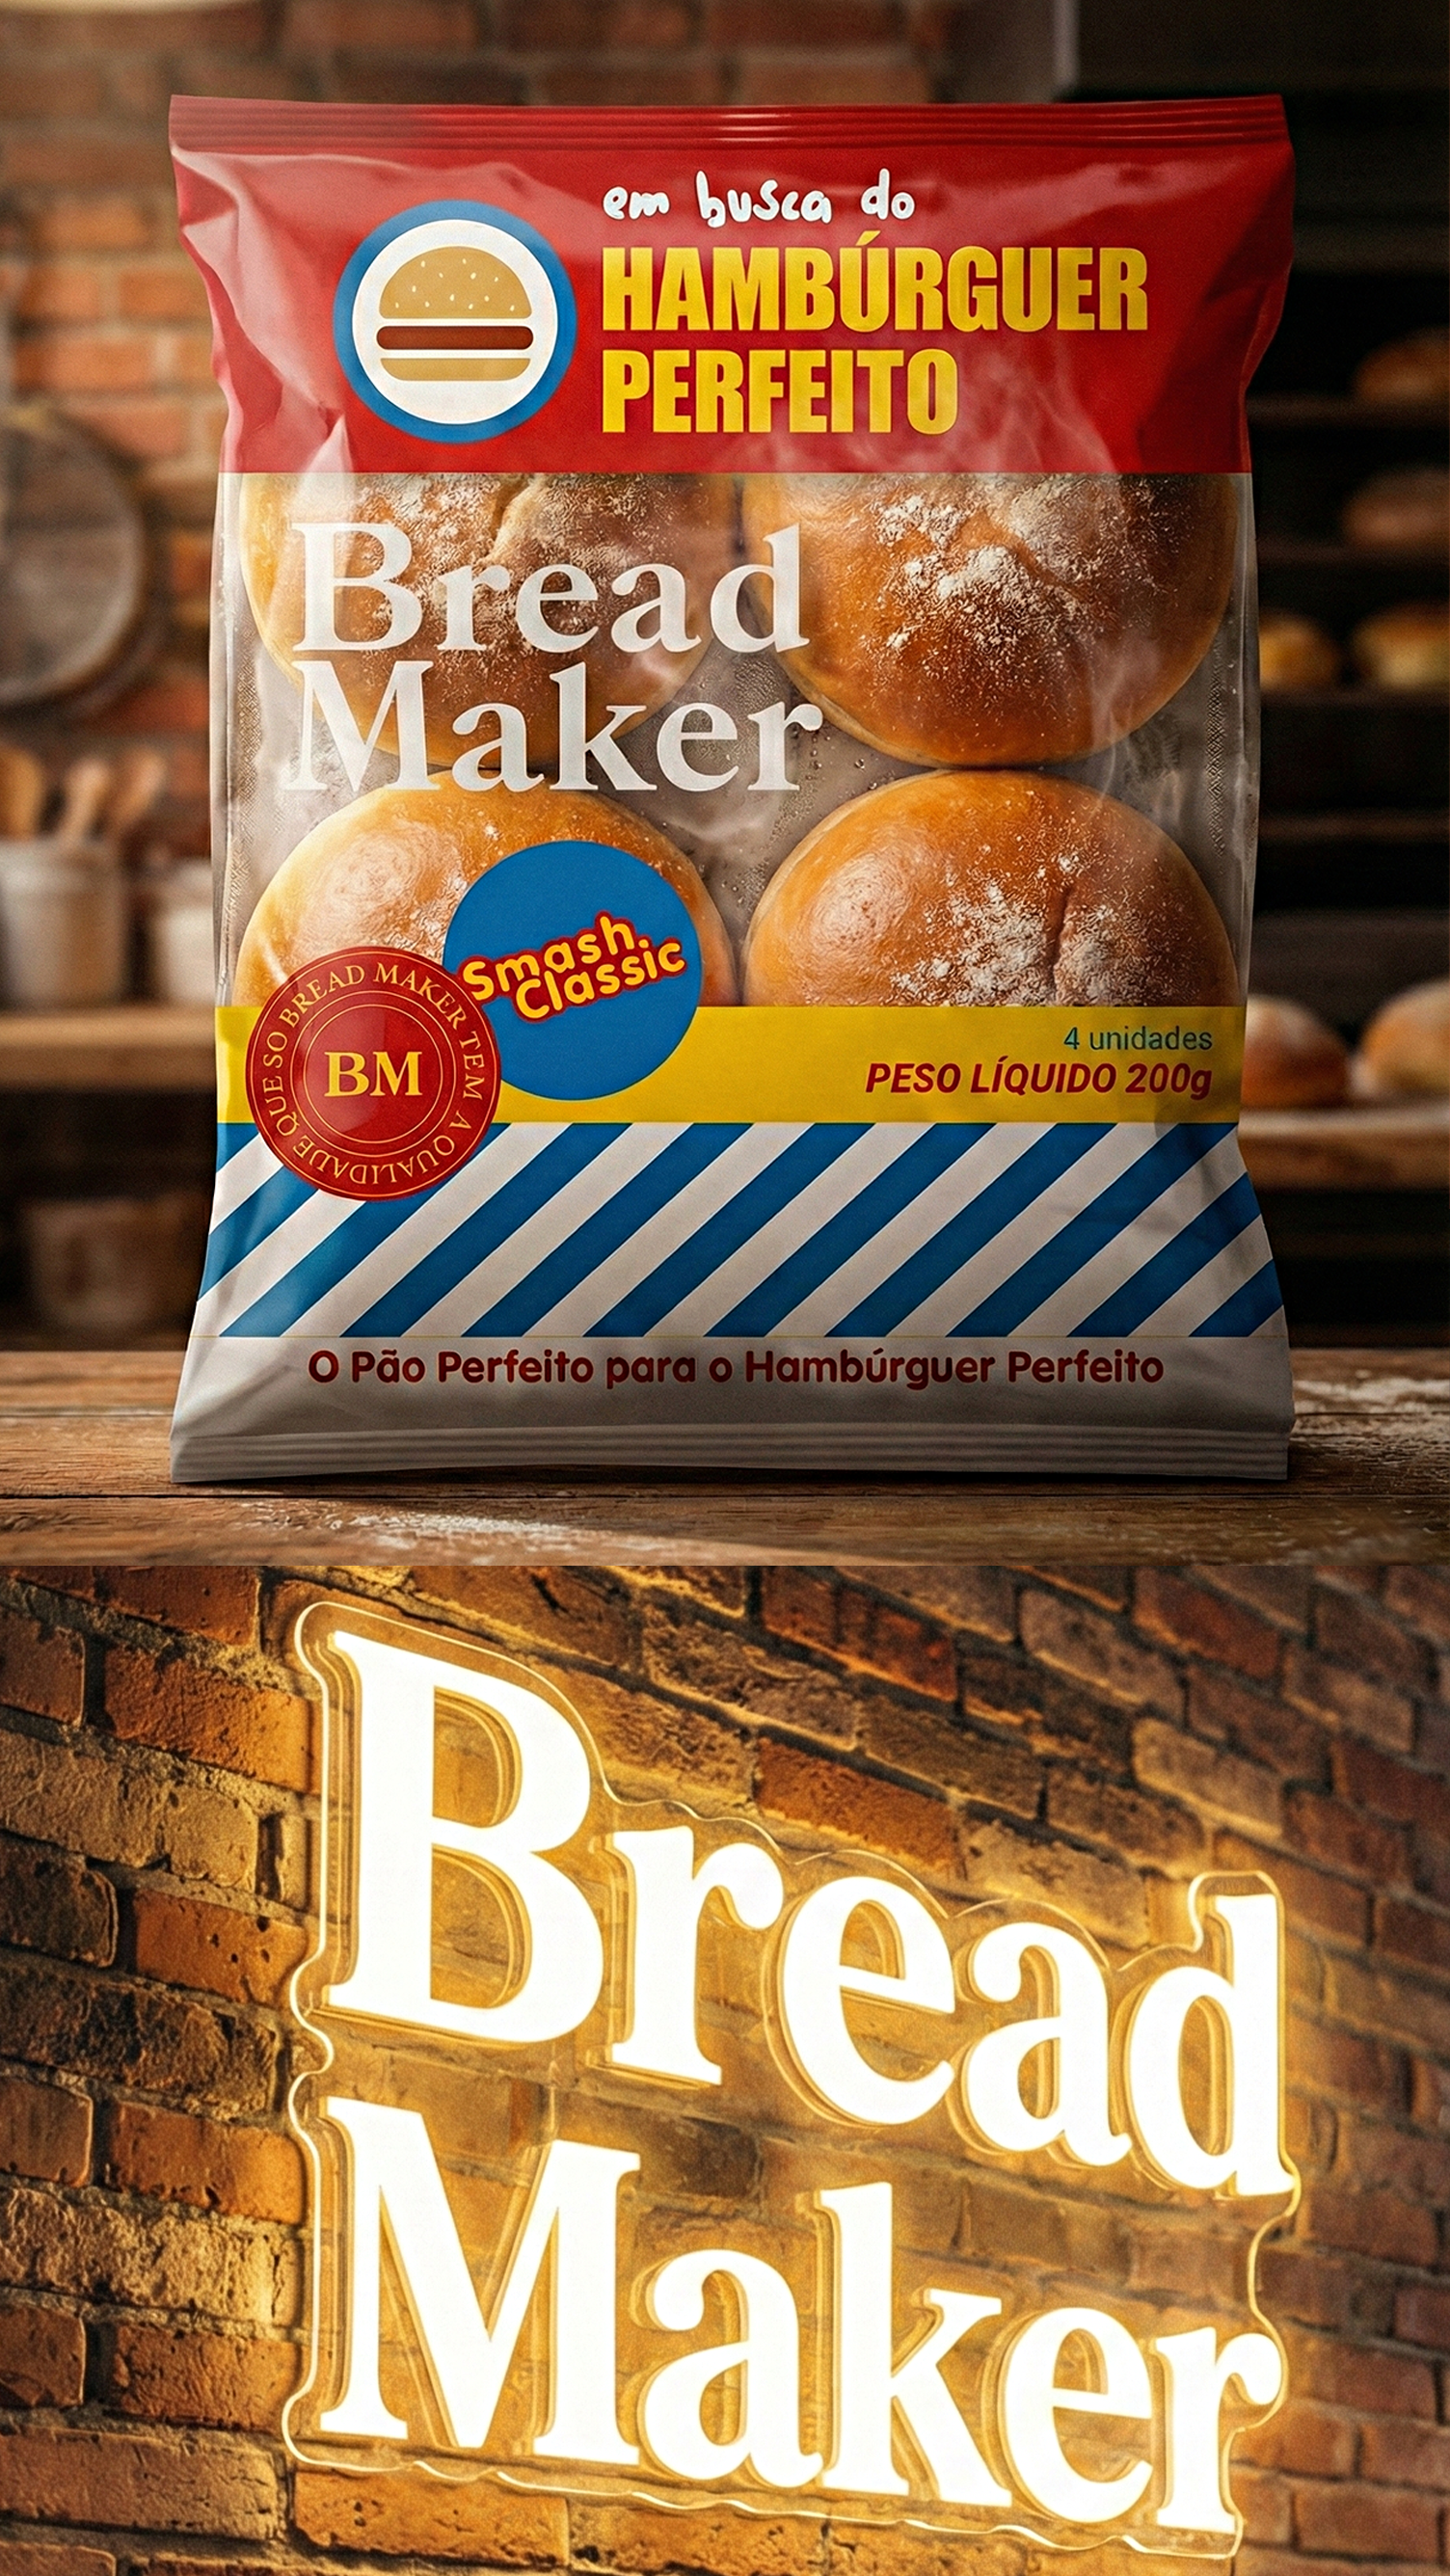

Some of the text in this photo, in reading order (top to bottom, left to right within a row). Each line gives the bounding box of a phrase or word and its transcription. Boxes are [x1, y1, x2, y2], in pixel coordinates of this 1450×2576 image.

[603, 168, 915, 228] em busca do
[603, 229, 1148, 333] HAMBÚRGUER
[603, 348, 959, 436] PERFEITO
[290, 522, 810, 653] Bread
[283, 659, 823, 792] Maker
[279, 965, 365, 1028] BREAD
[373, 962, 467, 1030] MAKER
[516, 939, 685, 1019] Classic
[459, 1031, 485, 1100] TEM
[1063, 1026, 1213, 1050] 4 unidades
[262, 1076, 300, 1136] QUE
[324, 1051, 423, 1097] BM
[866, 1056, 1213, 1100] PESO LÍQUIDO 200g
[449, 1110, 471, 1129] A
[309, 1347, 1165, 1390] O Pão Perfeito para o Hambúrguer Perfeito
[326, 1630, 1298, 2197] Bread
[319, 2096, 1282, 2534] Maker
